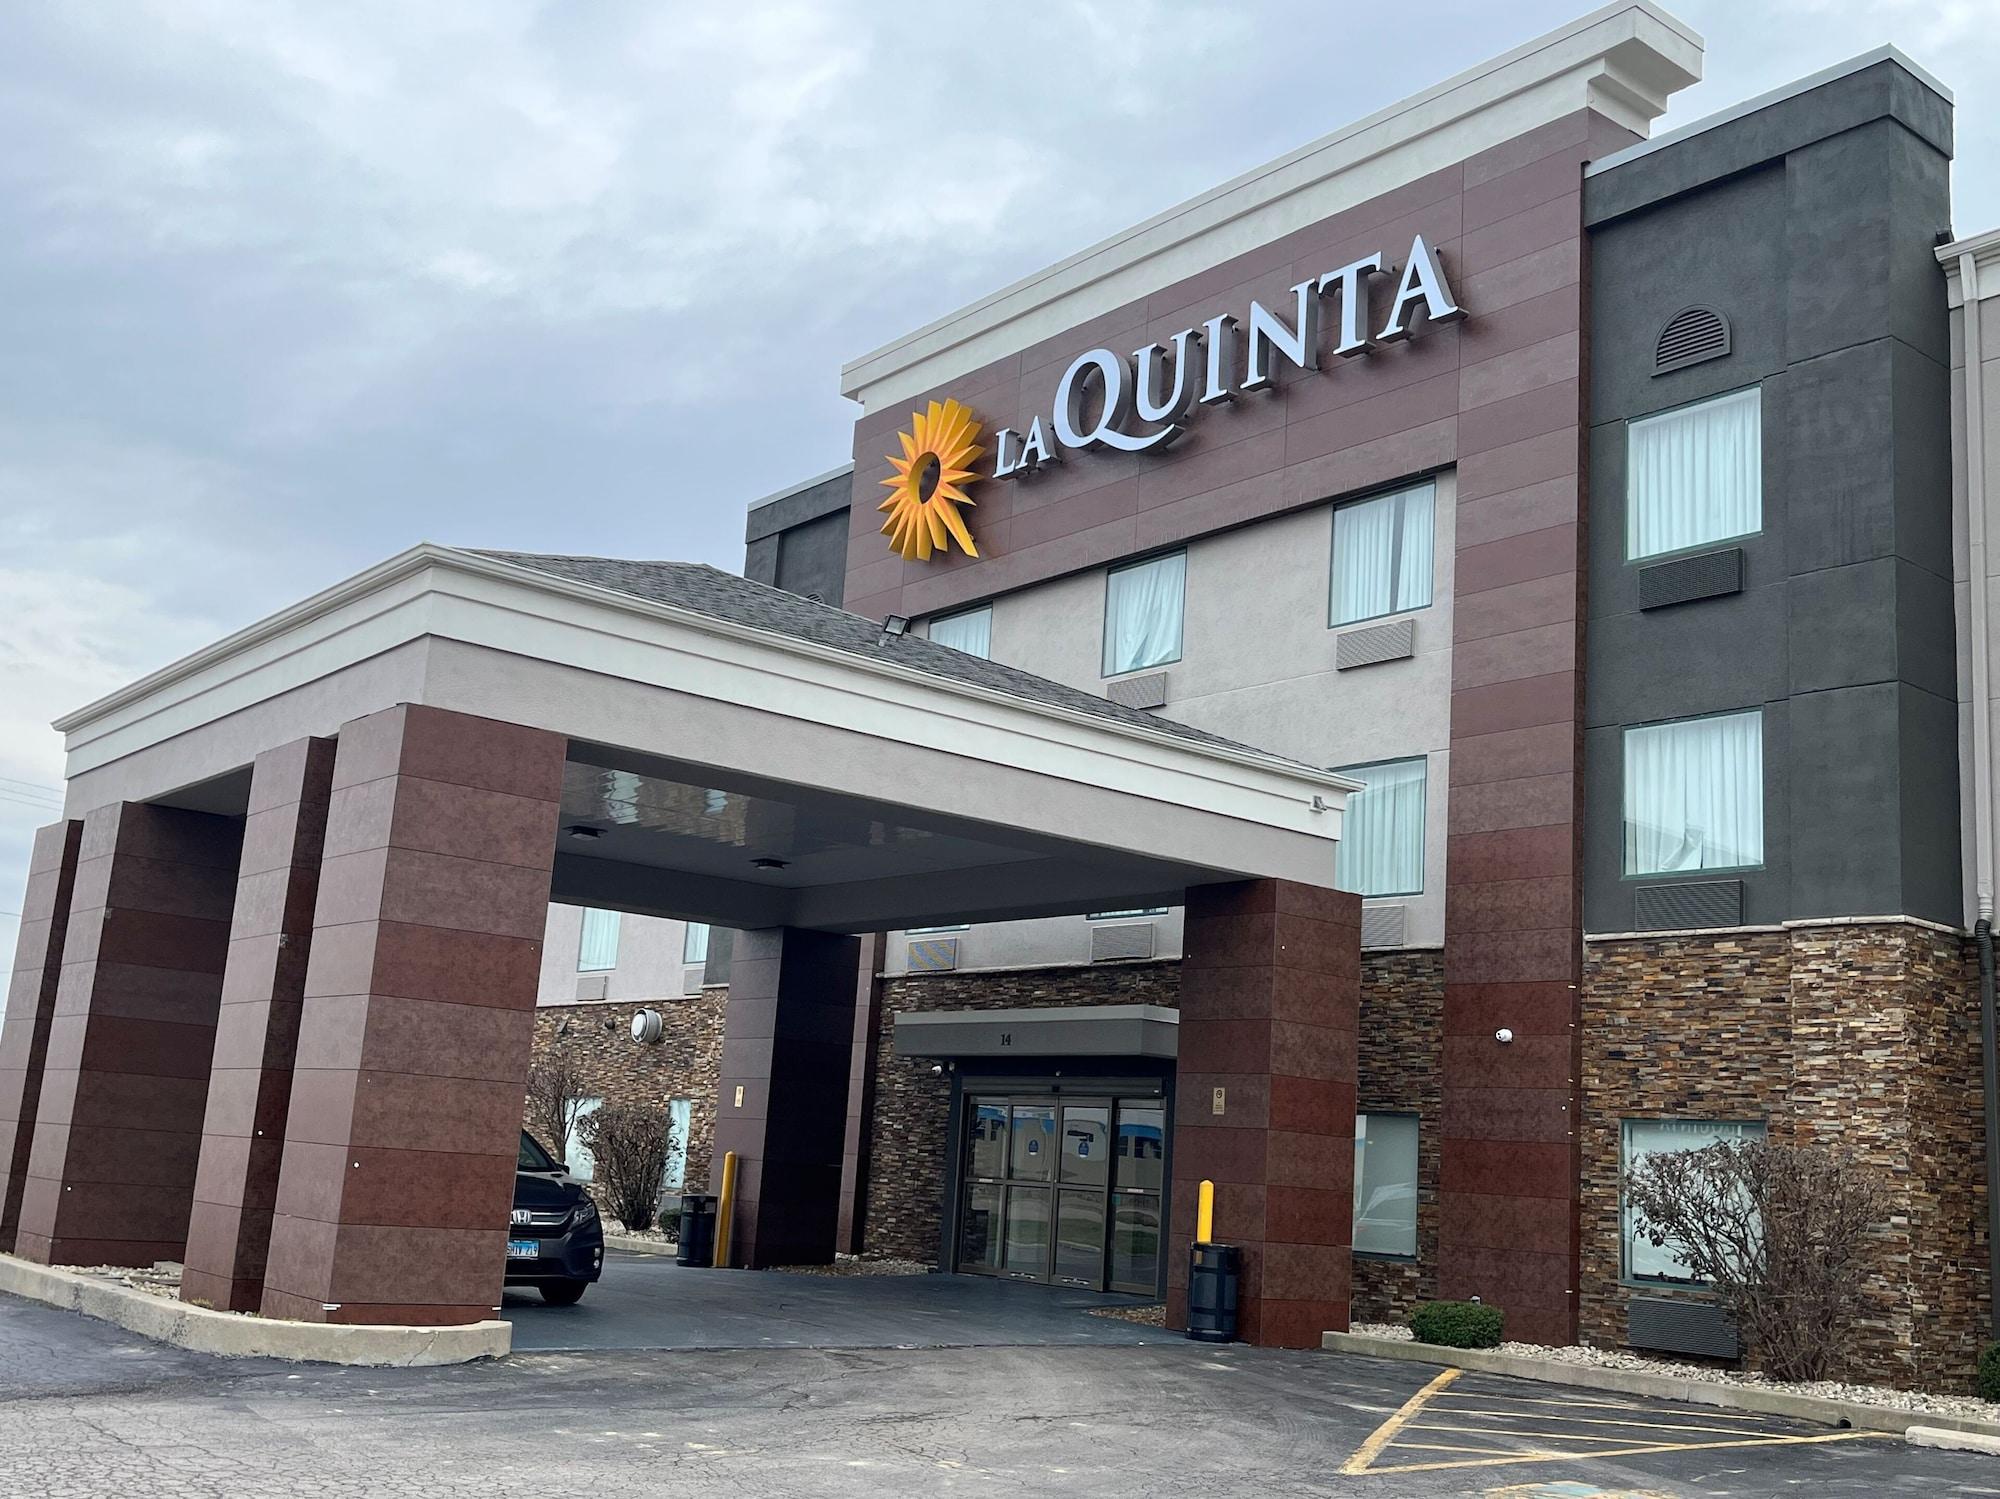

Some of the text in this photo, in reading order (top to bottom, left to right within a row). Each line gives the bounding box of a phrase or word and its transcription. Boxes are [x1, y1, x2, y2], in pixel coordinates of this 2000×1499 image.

[992, 234, 1466, 480] LA QUINTA
[1000, 1033, 1011, 1046] 14
